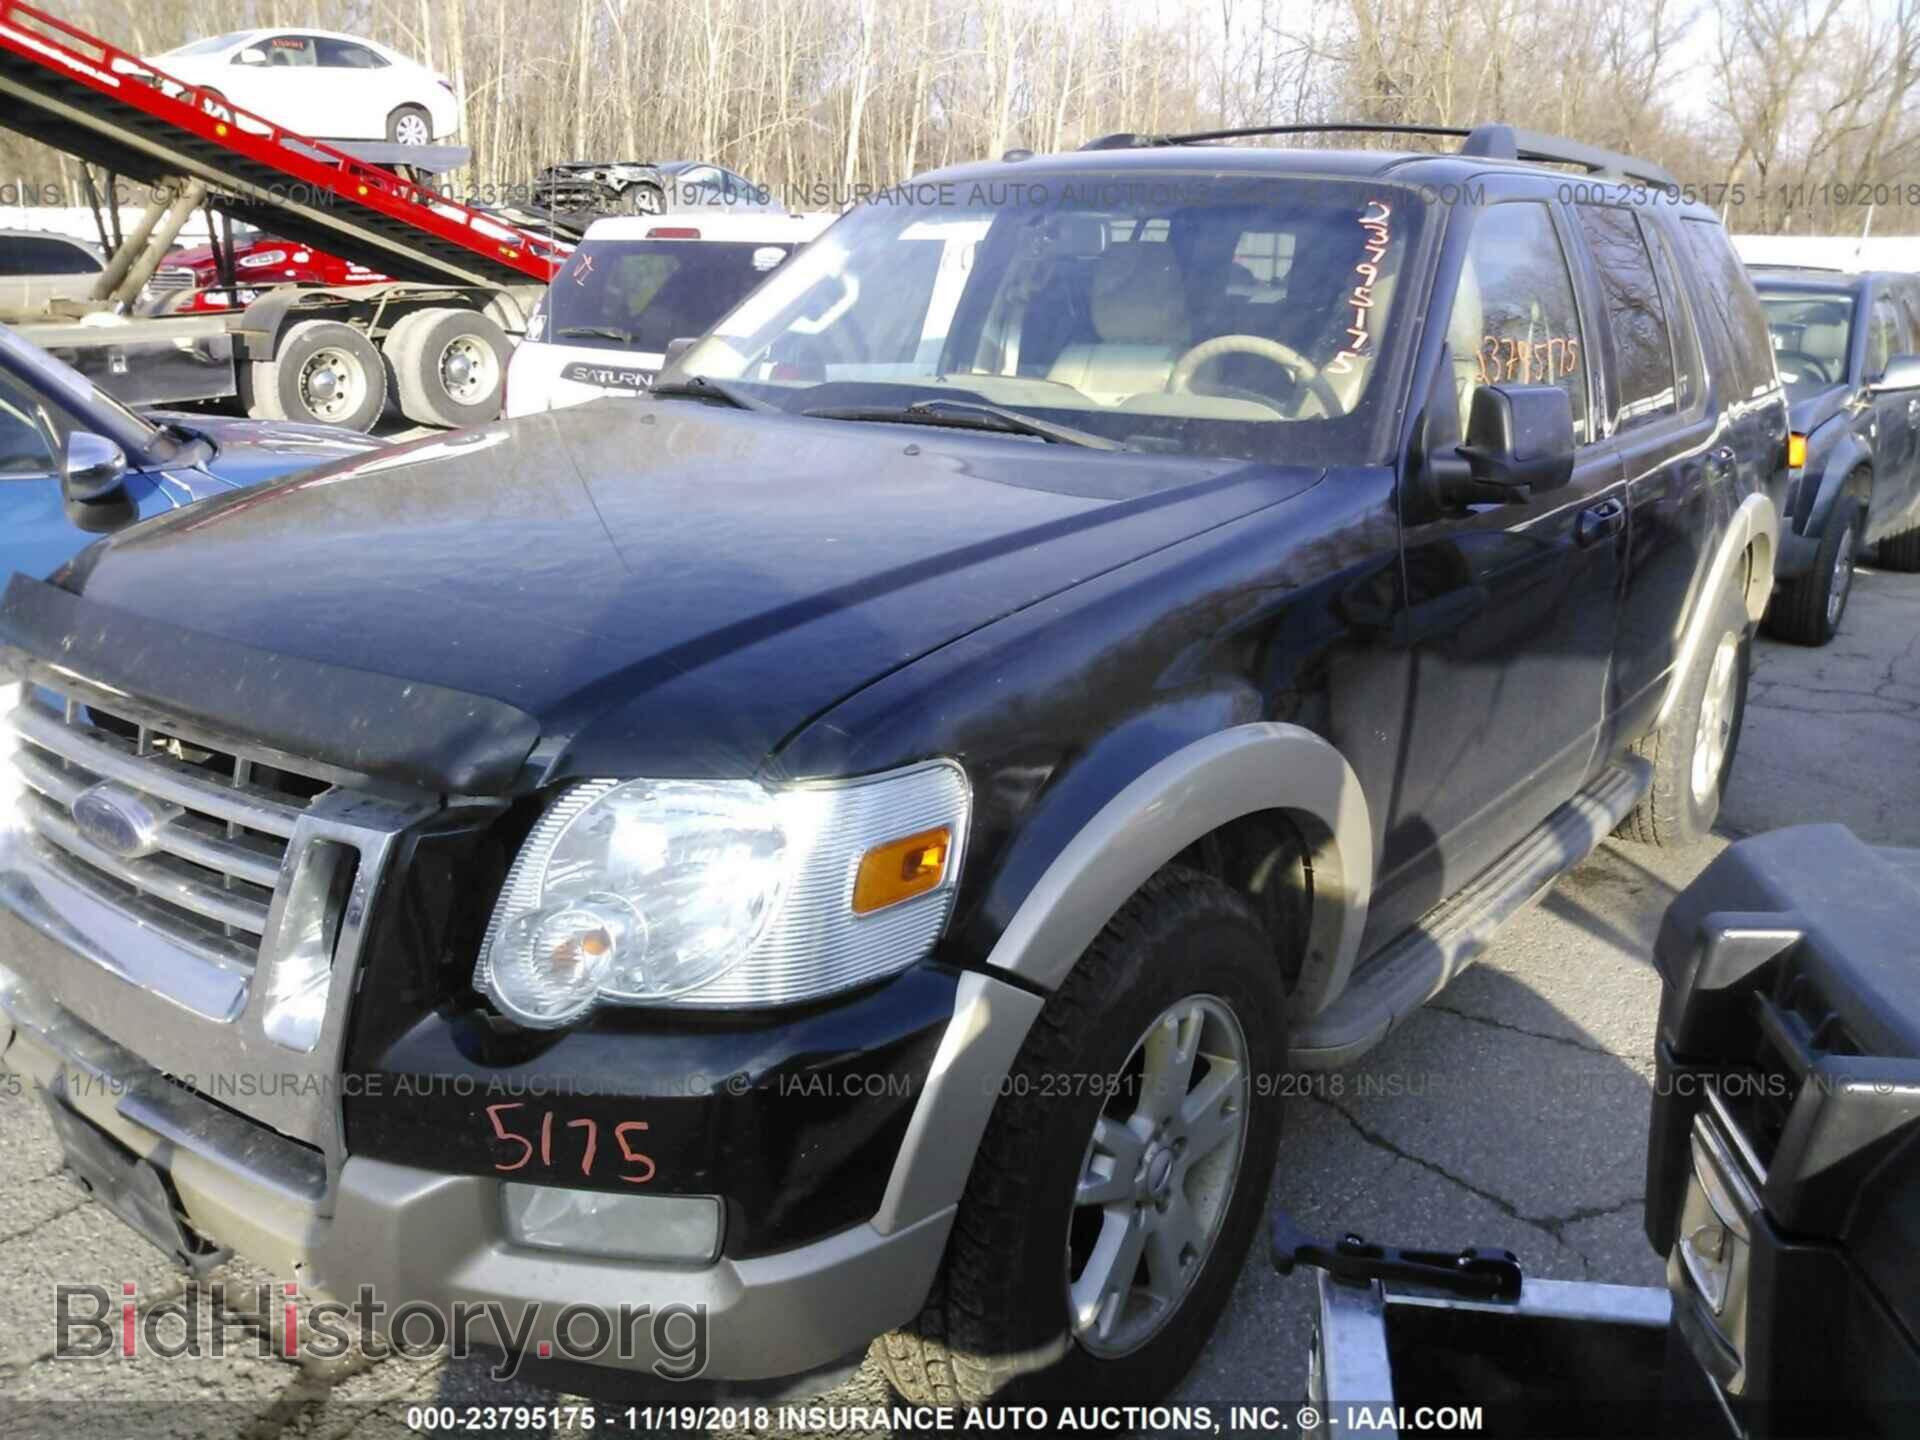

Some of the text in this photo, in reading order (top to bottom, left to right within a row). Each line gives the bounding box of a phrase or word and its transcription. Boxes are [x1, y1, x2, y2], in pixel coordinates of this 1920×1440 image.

[1327, 200, 1391, 375] 23795175
[573, 367, 654, 386] SATURN
[486, 1103, 657, 1184] 5175
